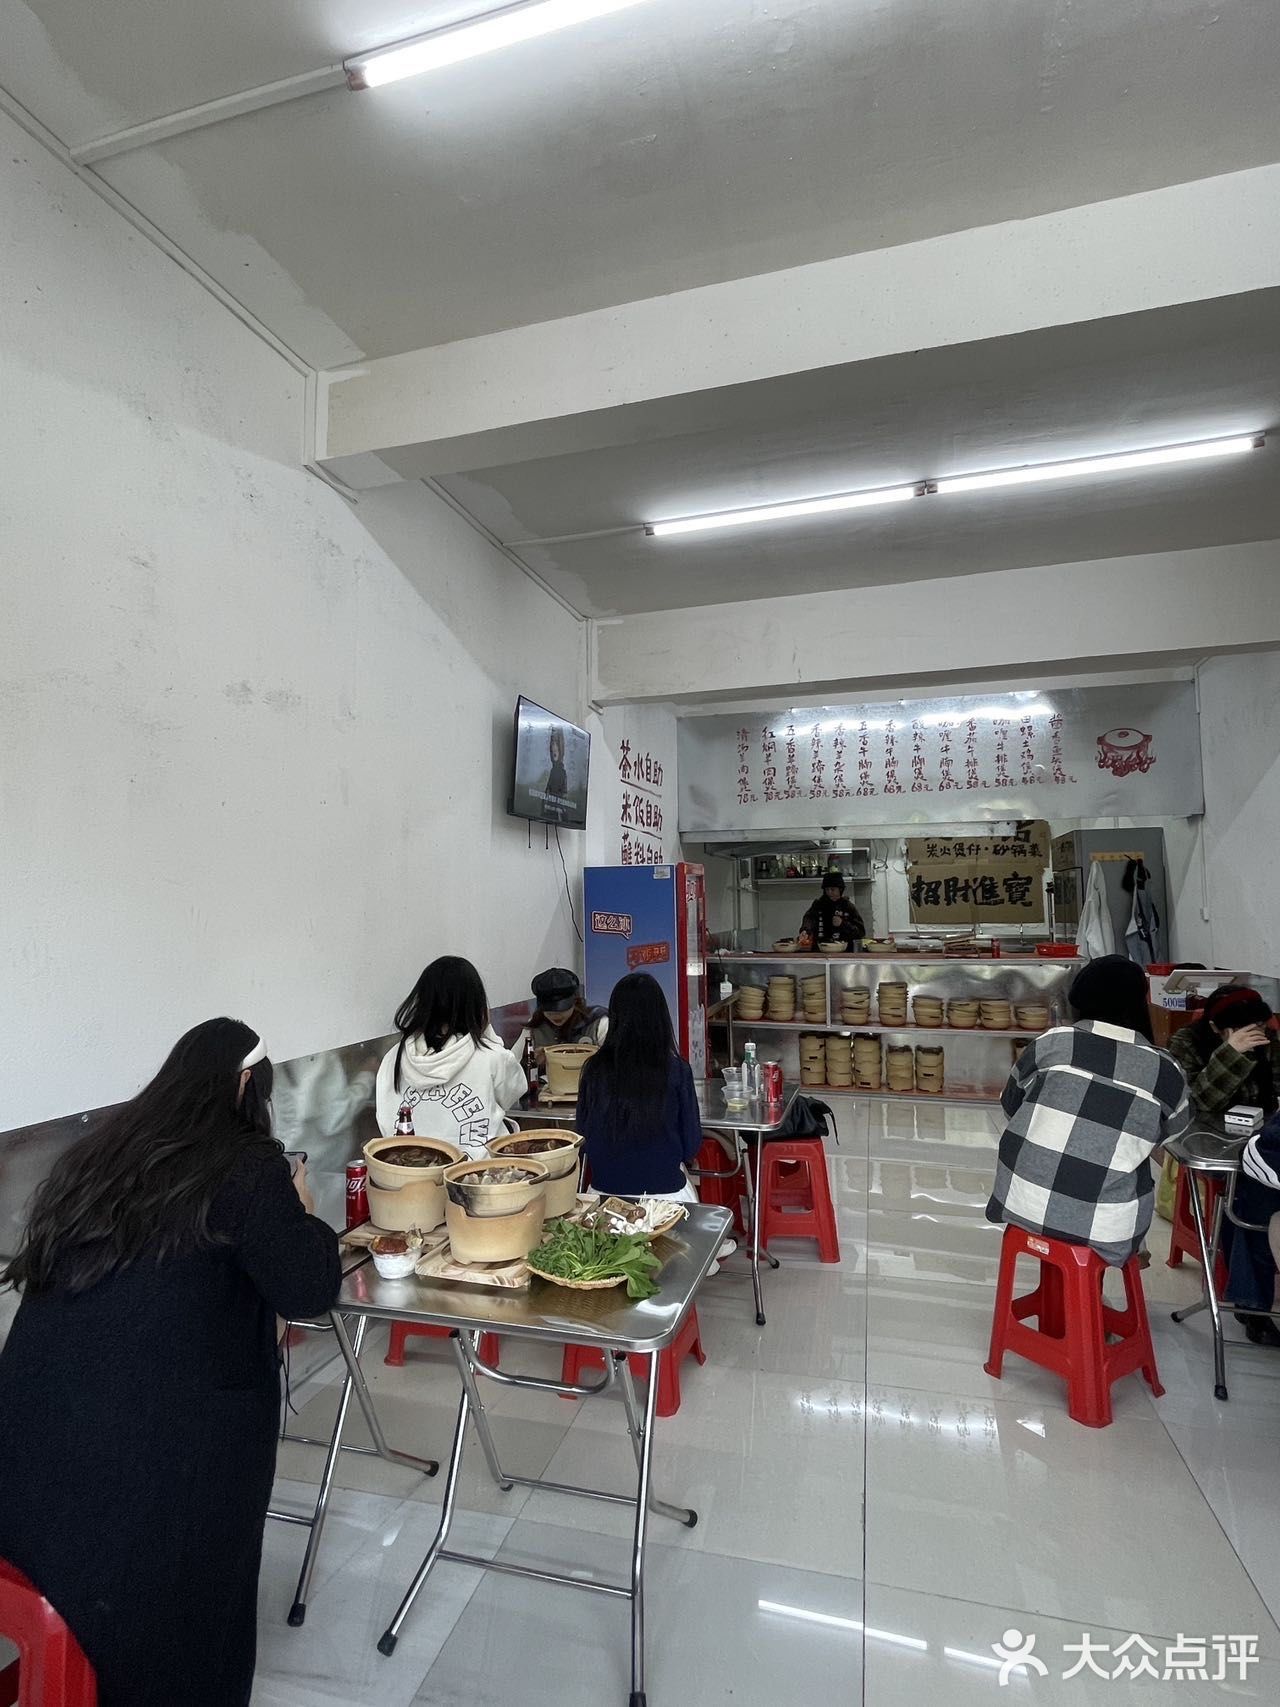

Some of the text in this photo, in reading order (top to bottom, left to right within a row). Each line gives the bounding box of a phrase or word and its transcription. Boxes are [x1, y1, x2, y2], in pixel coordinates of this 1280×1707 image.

[618, 739, 663, 787] 茶水自助
[620, 790, 663, 833] 米饭自助
[1162, 997, 1178, 1008] 500
